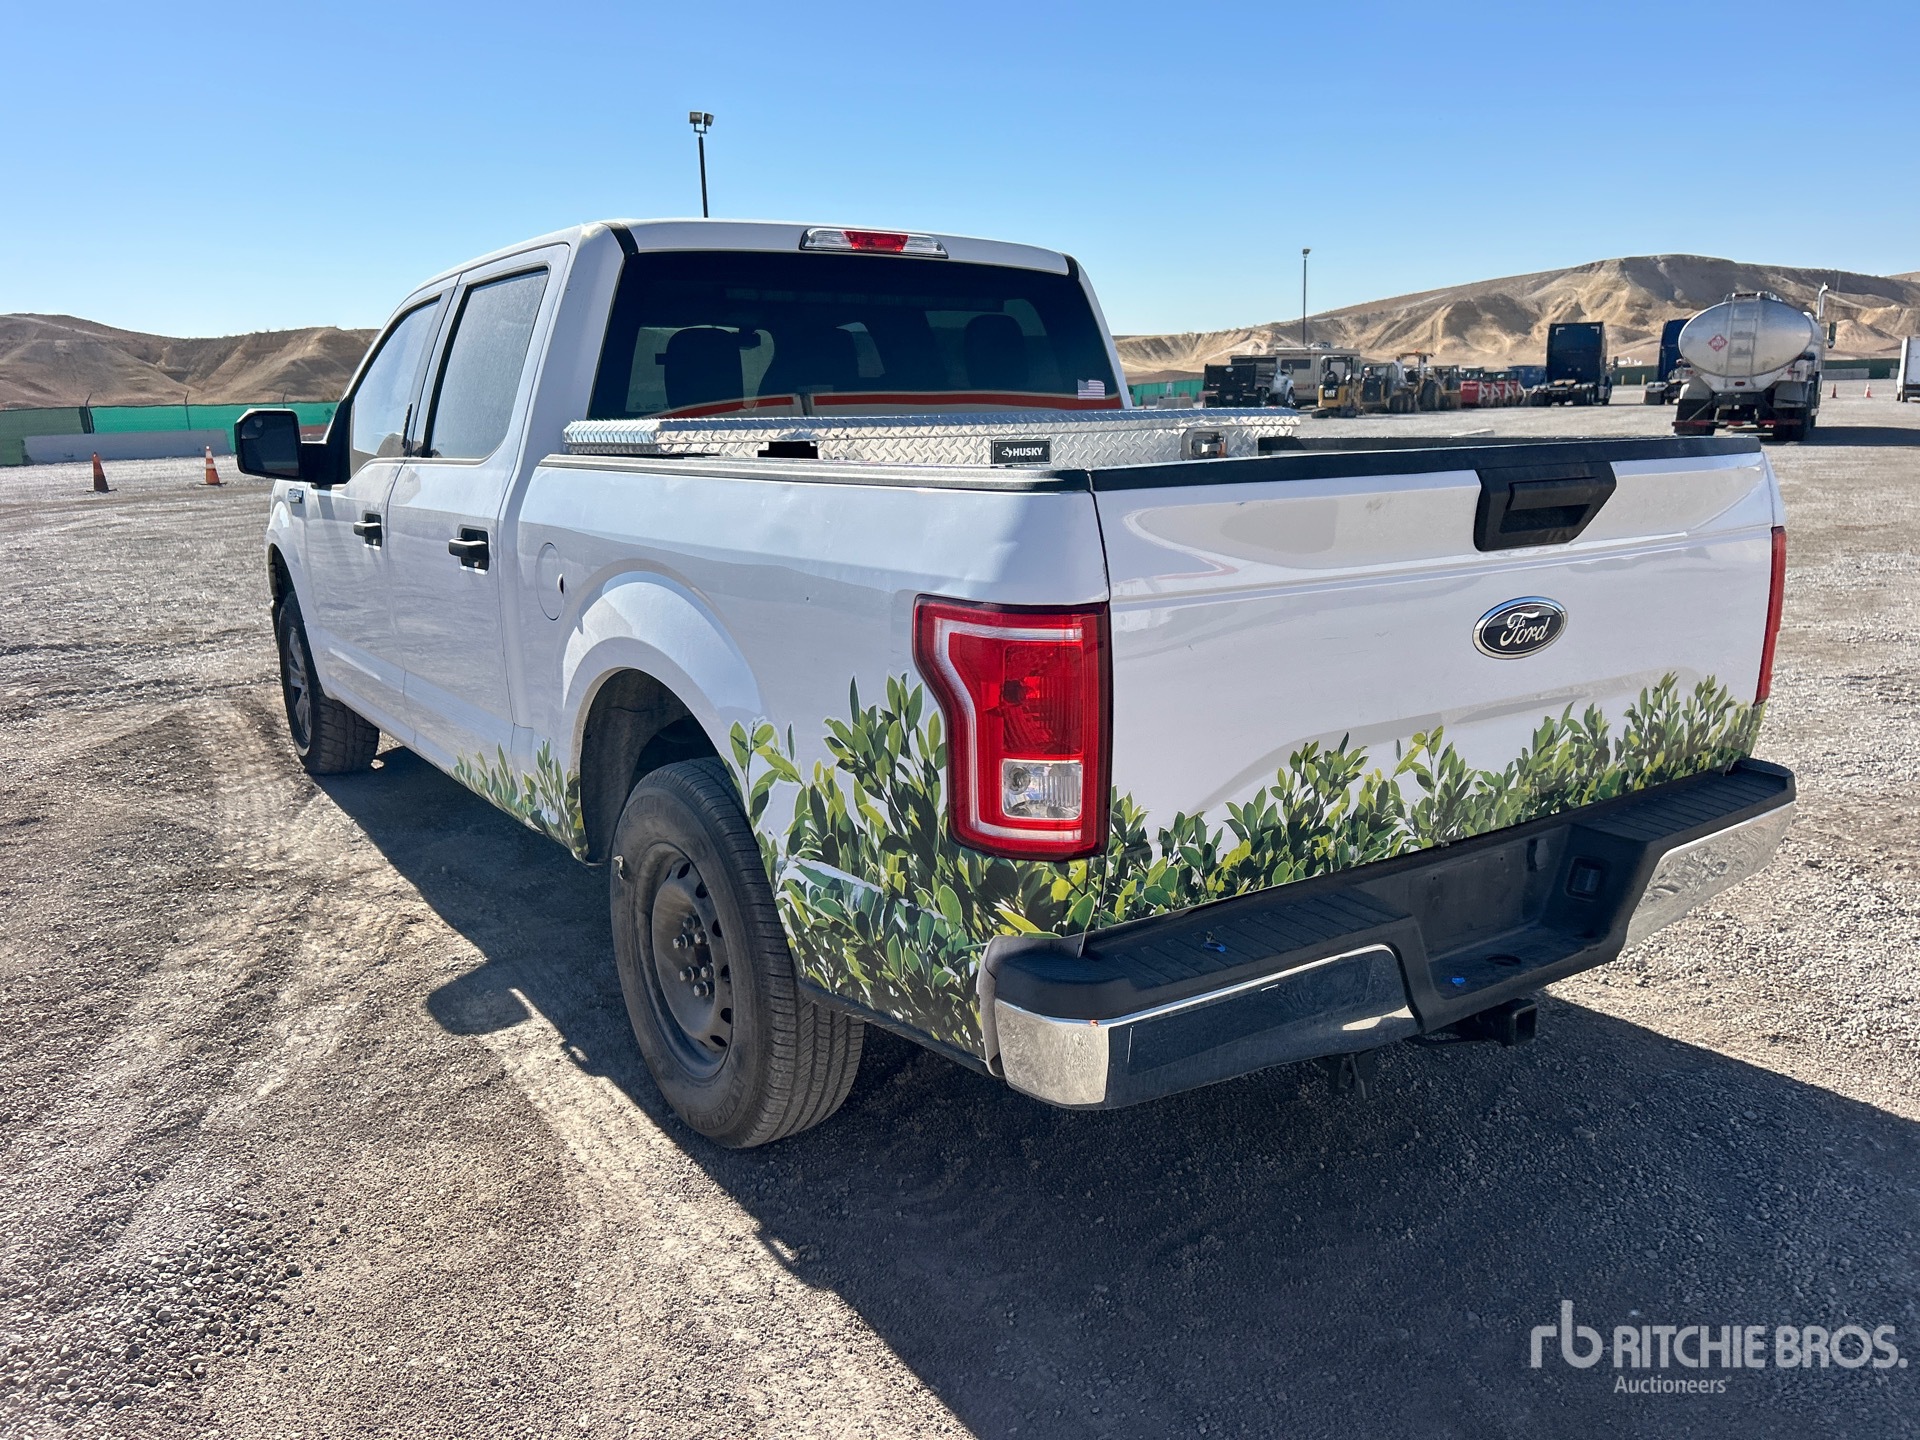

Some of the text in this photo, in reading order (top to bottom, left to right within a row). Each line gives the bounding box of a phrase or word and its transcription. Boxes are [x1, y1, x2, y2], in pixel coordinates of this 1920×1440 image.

[1324, 389, 1336, 398] CAT
[1012, 447, 1043, 457] HUSKY
[1500, 611, 1551, 646] Ford
